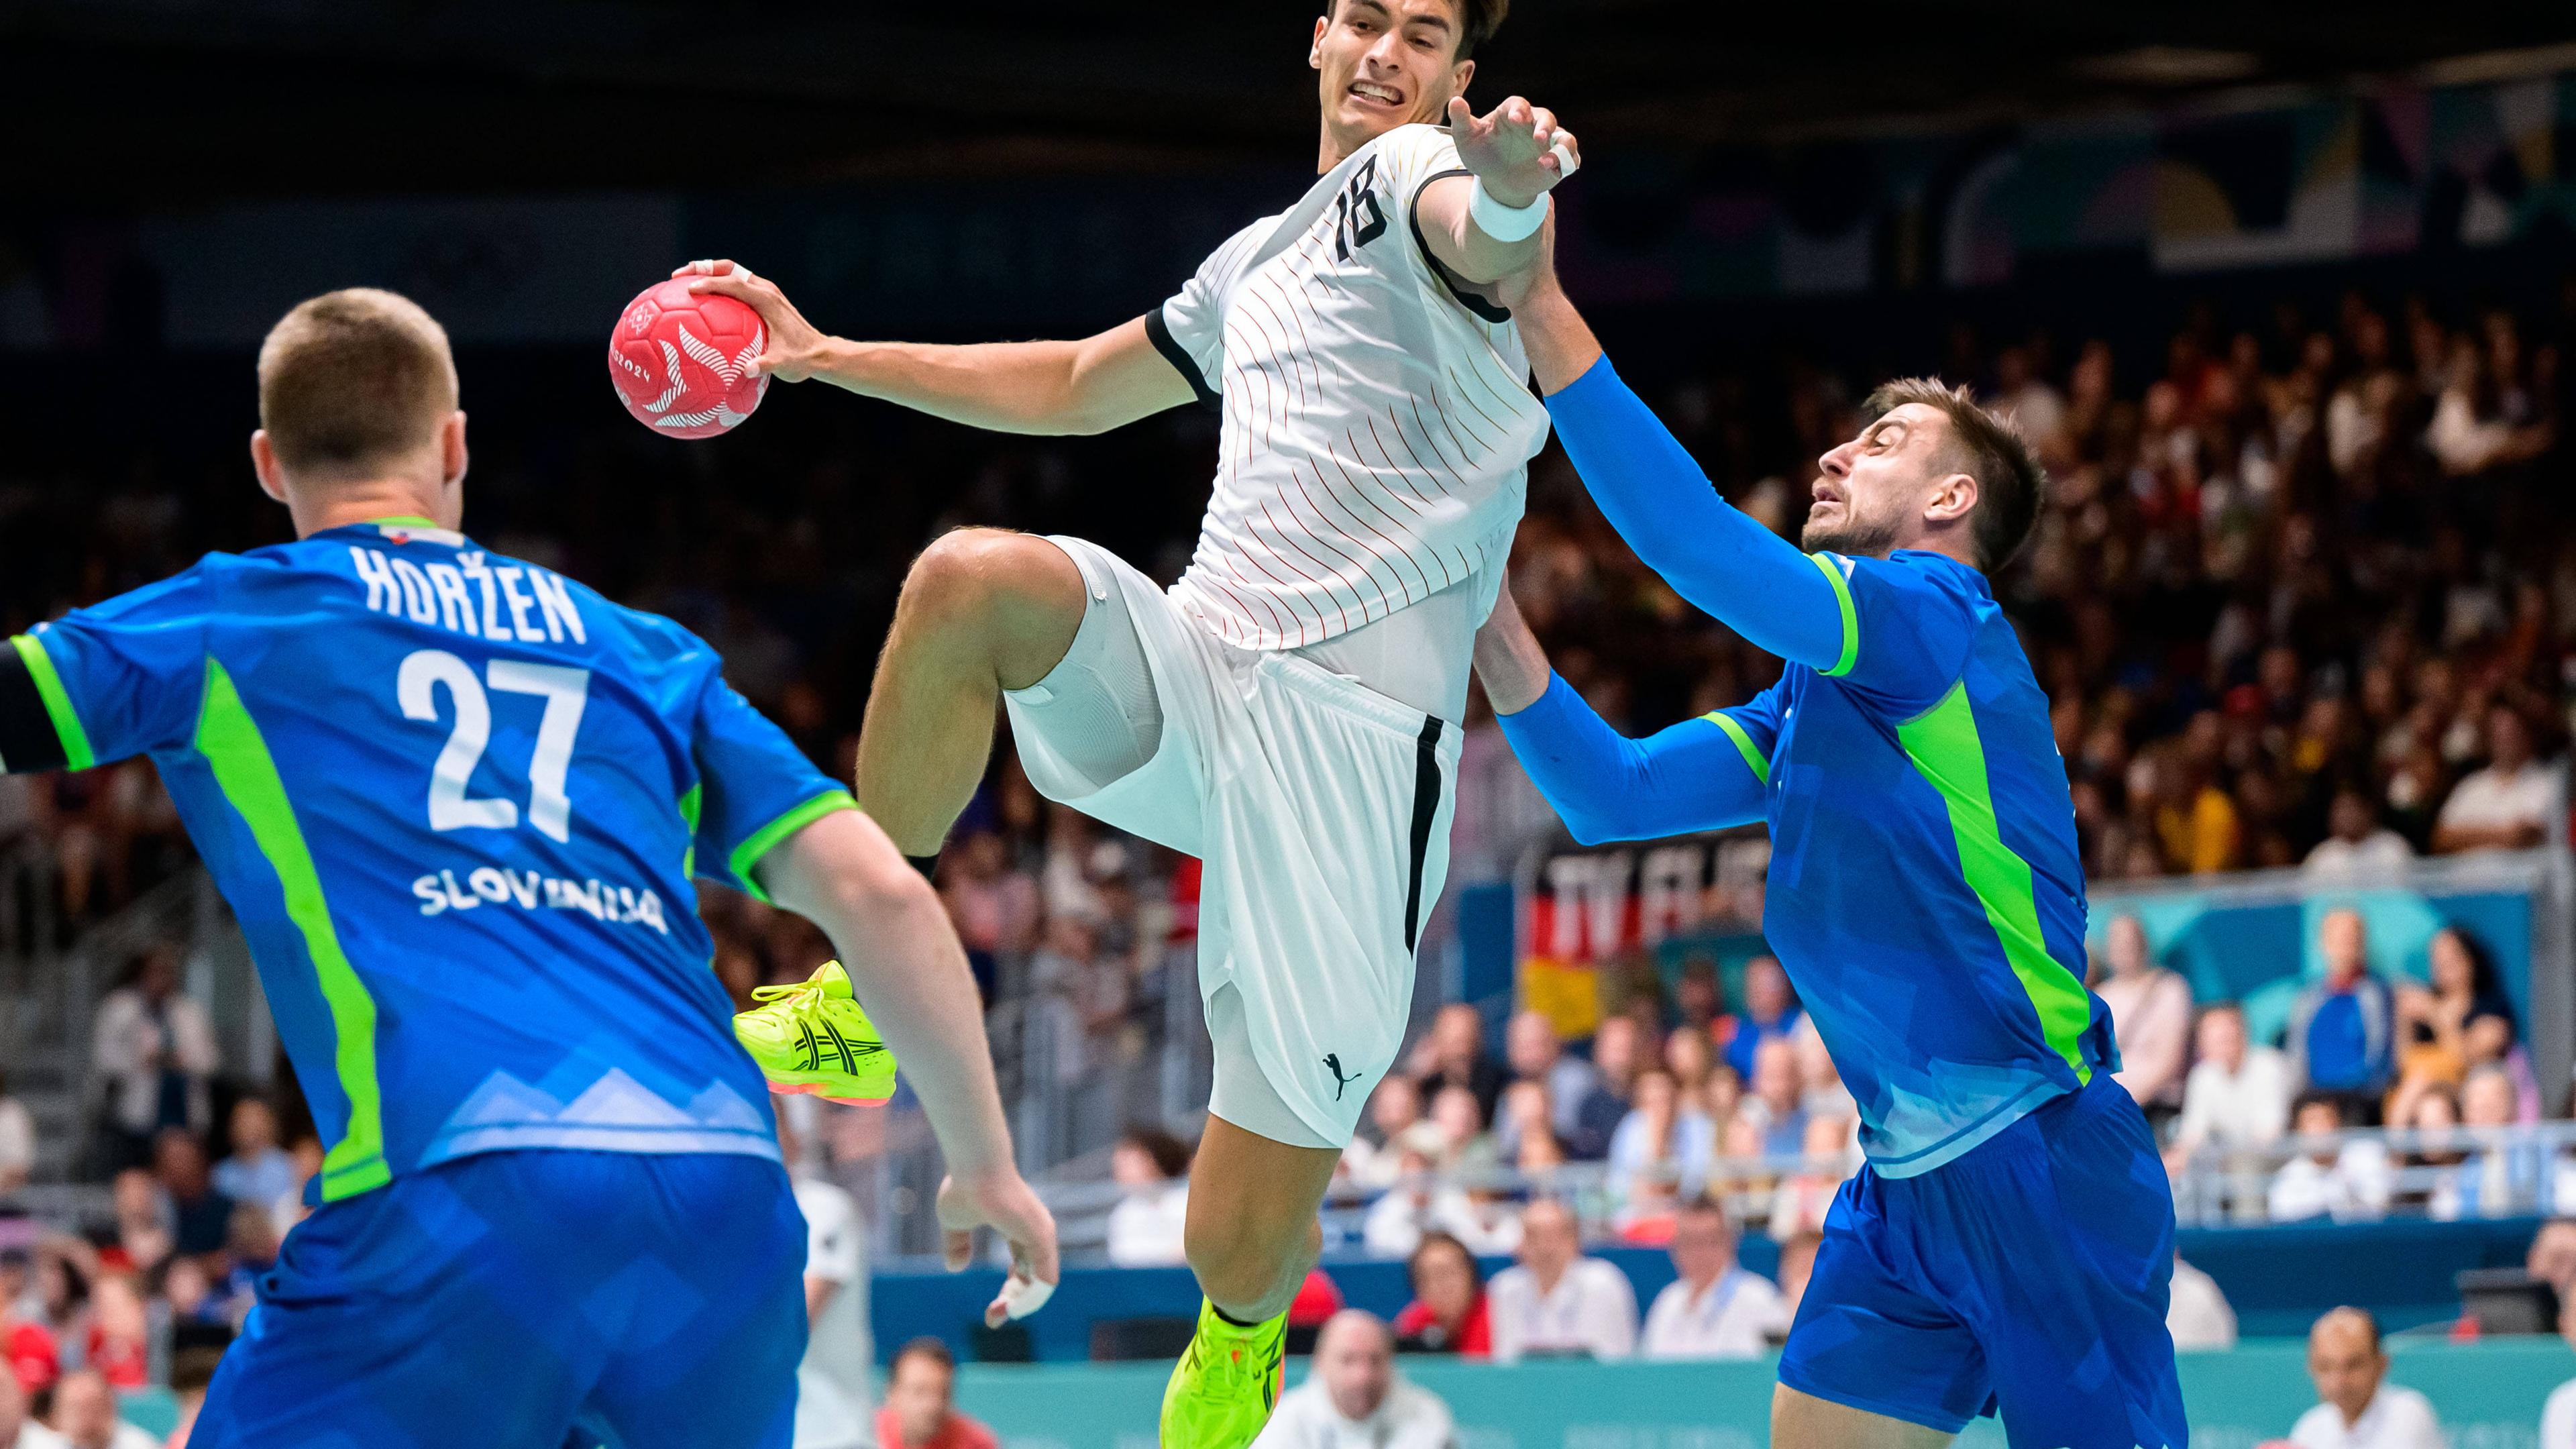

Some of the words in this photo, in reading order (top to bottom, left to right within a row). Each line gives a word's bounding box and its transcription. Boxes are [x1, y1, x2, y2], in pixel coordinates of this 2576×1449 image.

[1336, 154, 1387, 262] 18
[350, 547, 586, 643] HORŽEN
[397, 649, 590, 843] 27
